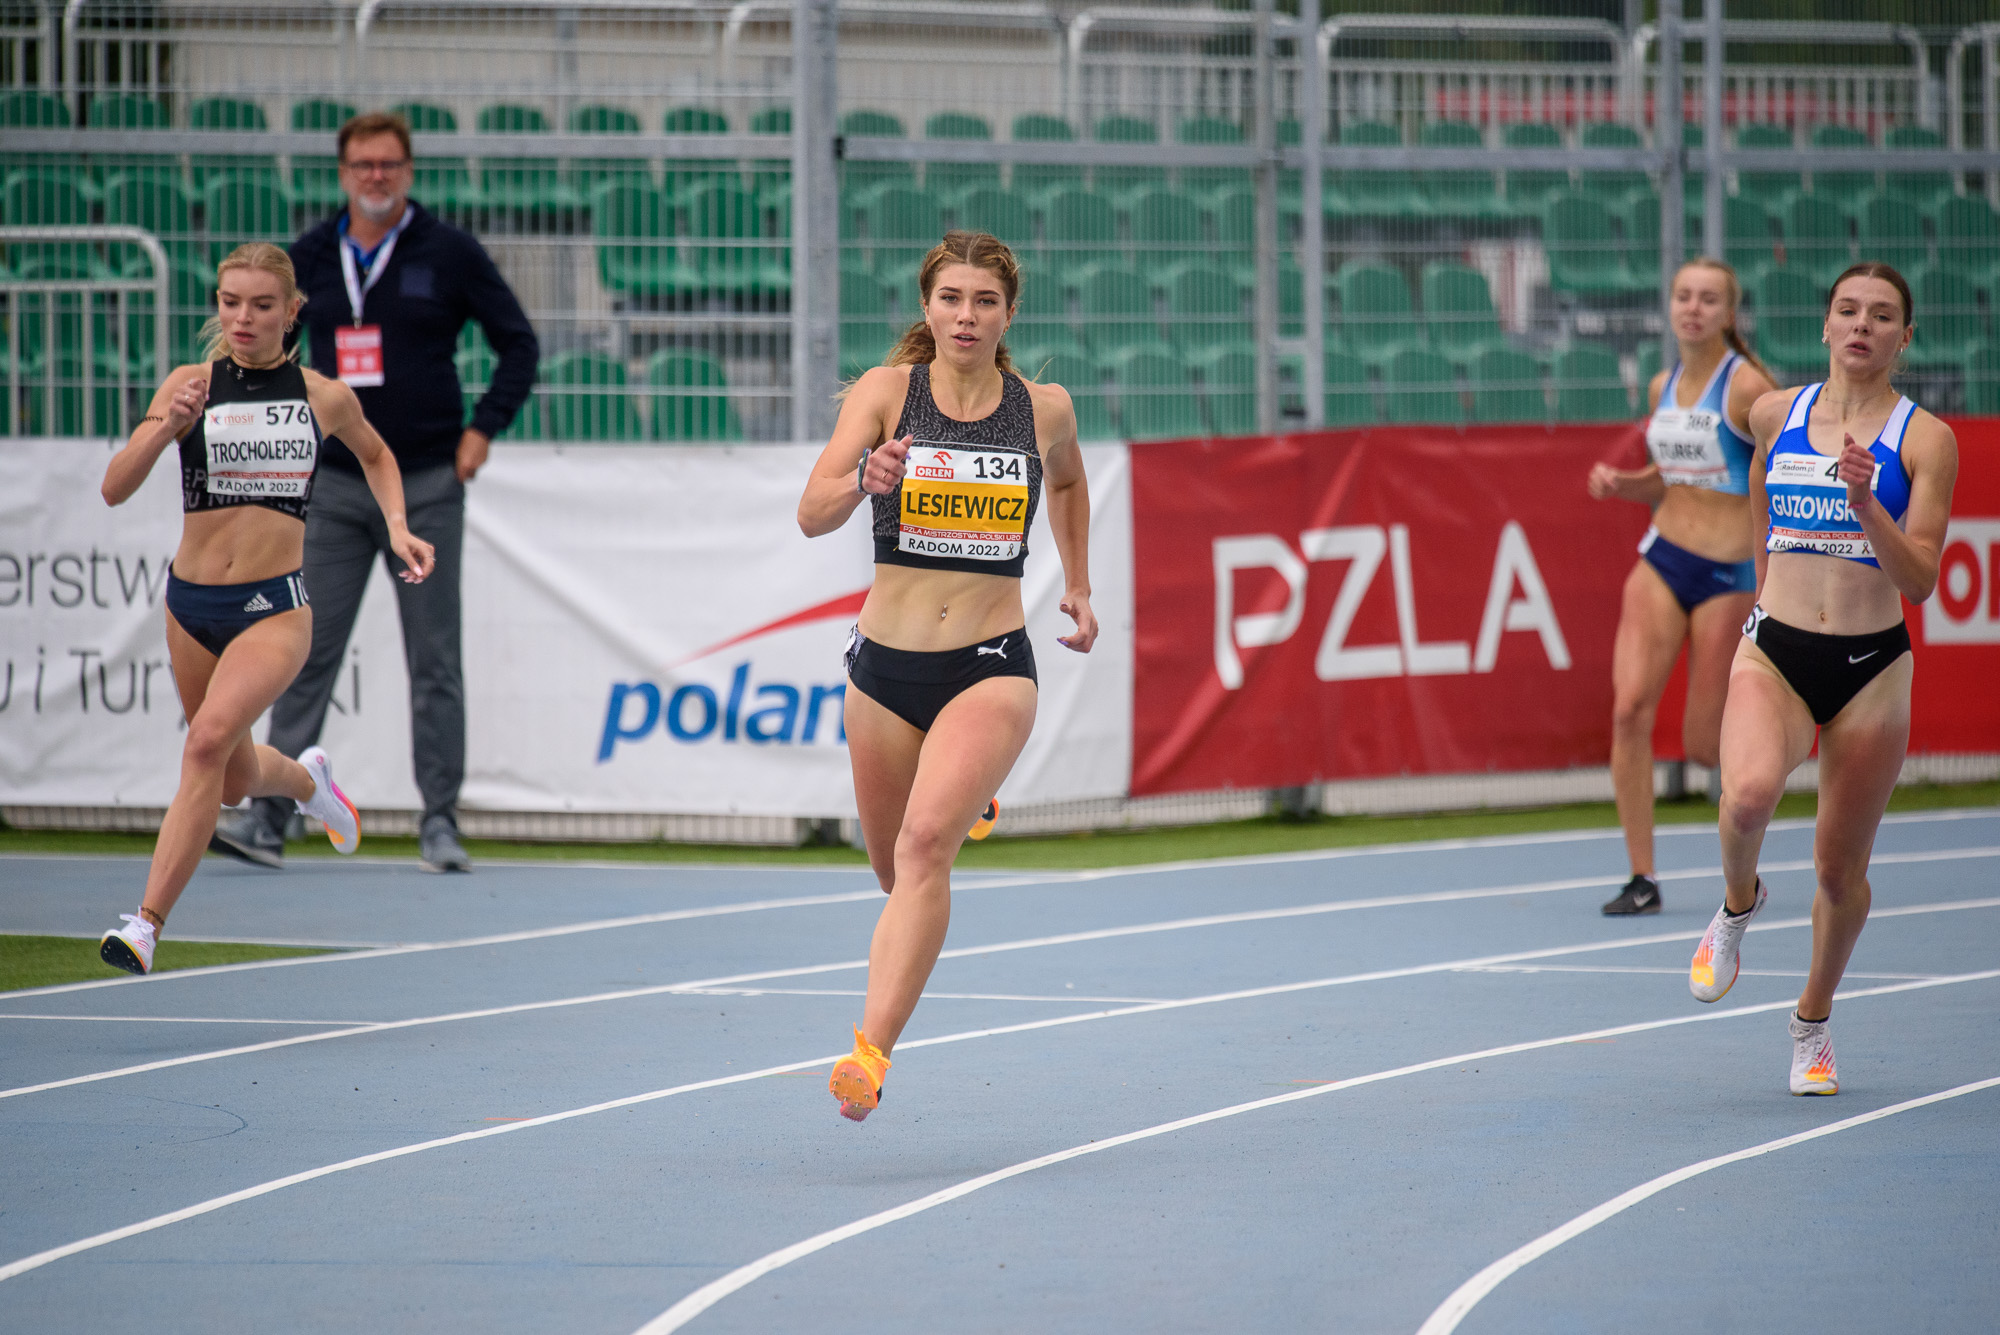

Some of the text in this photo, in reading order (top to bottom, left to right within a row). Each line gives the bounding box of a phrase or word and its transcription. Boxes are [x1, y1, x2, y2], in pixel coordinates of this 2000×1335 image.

[223, 413, 254, 424] mosir
[266, 405, 309, 425] 576
[211, 440, 314, 464] TROCHOLEPSZA
[1658, 443, 1707, 461] TUREK
[916, 467, 953, 478] ORLEN
[973, 456, 1021, 481] 134
[217, 480, 299, 494] RADOM 2022
[906, 491, 1025, 521] LESIEWICZ
[903, 525, 923, 535] PZLA
[924, 529, 979, 540] MISTRZOSTWA
[908, 537, 1001, 557] RADOM 2022
[1820, 543, 1853, 555] 2022
[244, 602, 273, 612] adidas
[1212, 519, 1572, 690] PZLA
